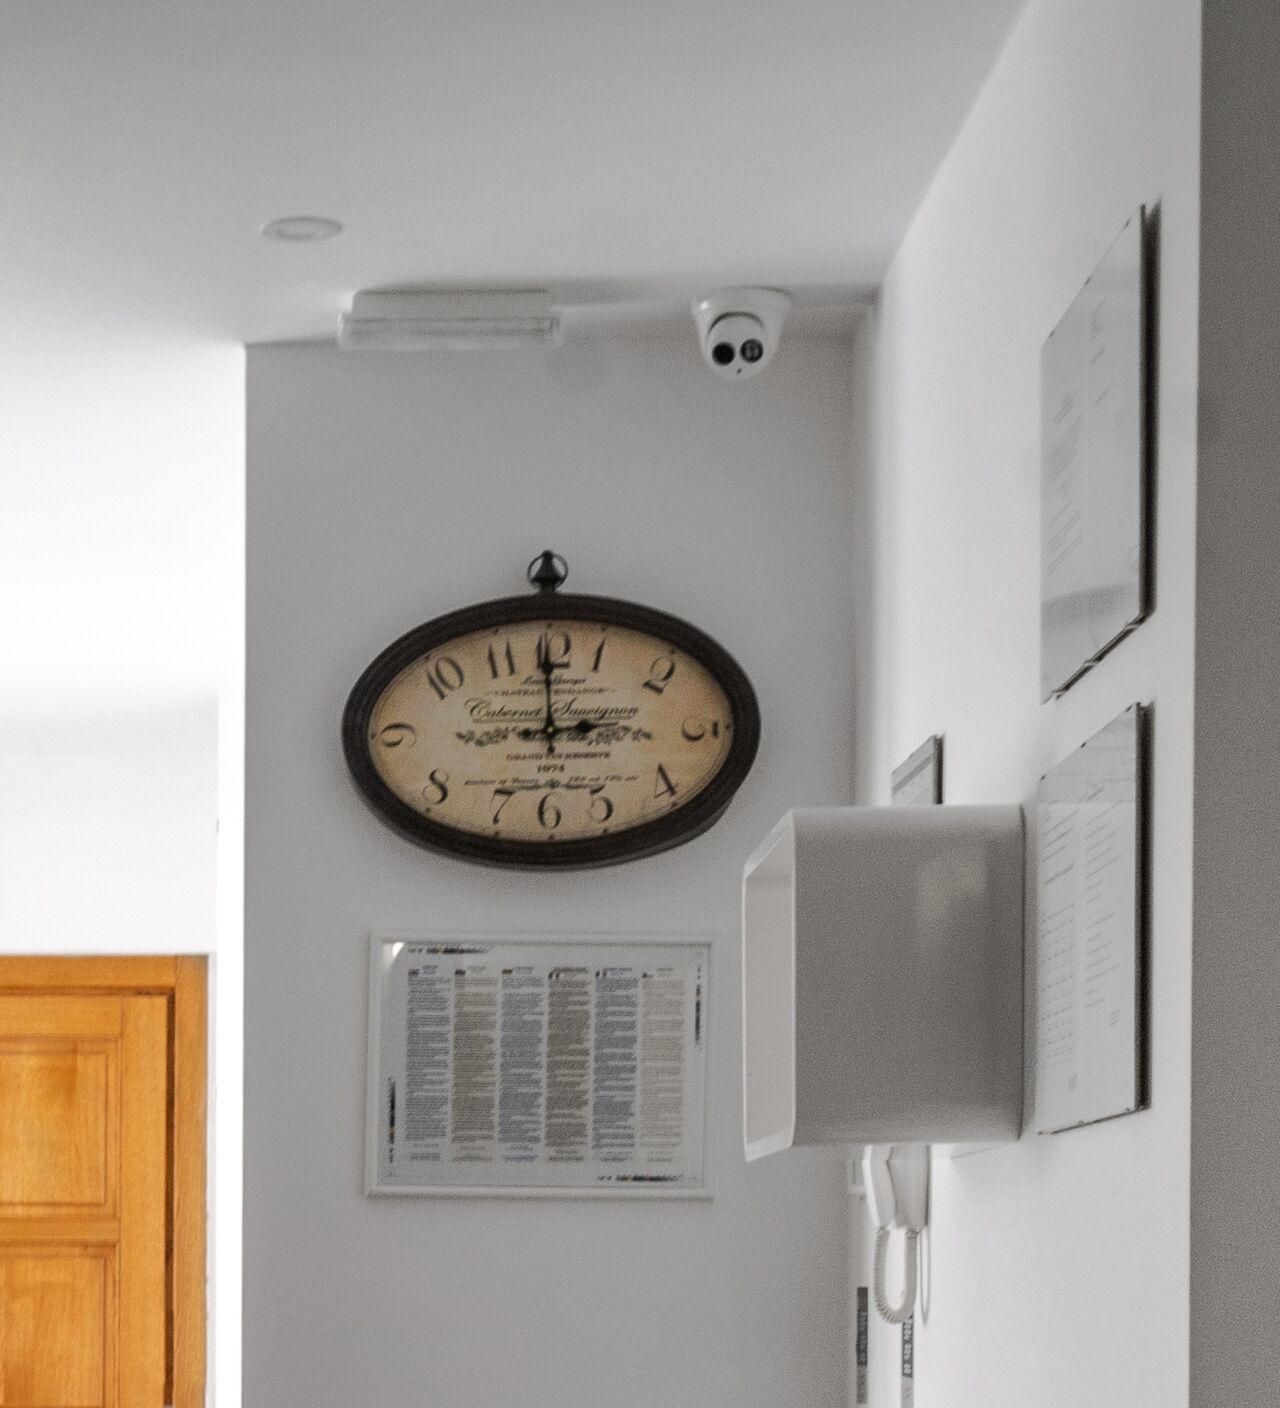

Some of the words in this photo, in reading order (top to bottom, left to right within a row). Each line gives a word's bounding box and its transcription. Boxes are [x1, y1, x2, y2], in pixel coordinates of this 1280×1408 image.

[487, 637, 516, 679] 11
[535, 631, 571, 670] 12
[591, 637, 607, 673] 1
[426, 656, 466, 700] 10
[642, 654, 676, 695] 2
[464, 697, 543, 719] Cabernet
[380, 722, 418, 749] 9
[422, 767, 449, 805] 8
[653, 763, 680, 801] 4
[492, 786, 517, 826] 7
[538, 791, 561, 830] 6
[588, 784, 614, 823] 5
